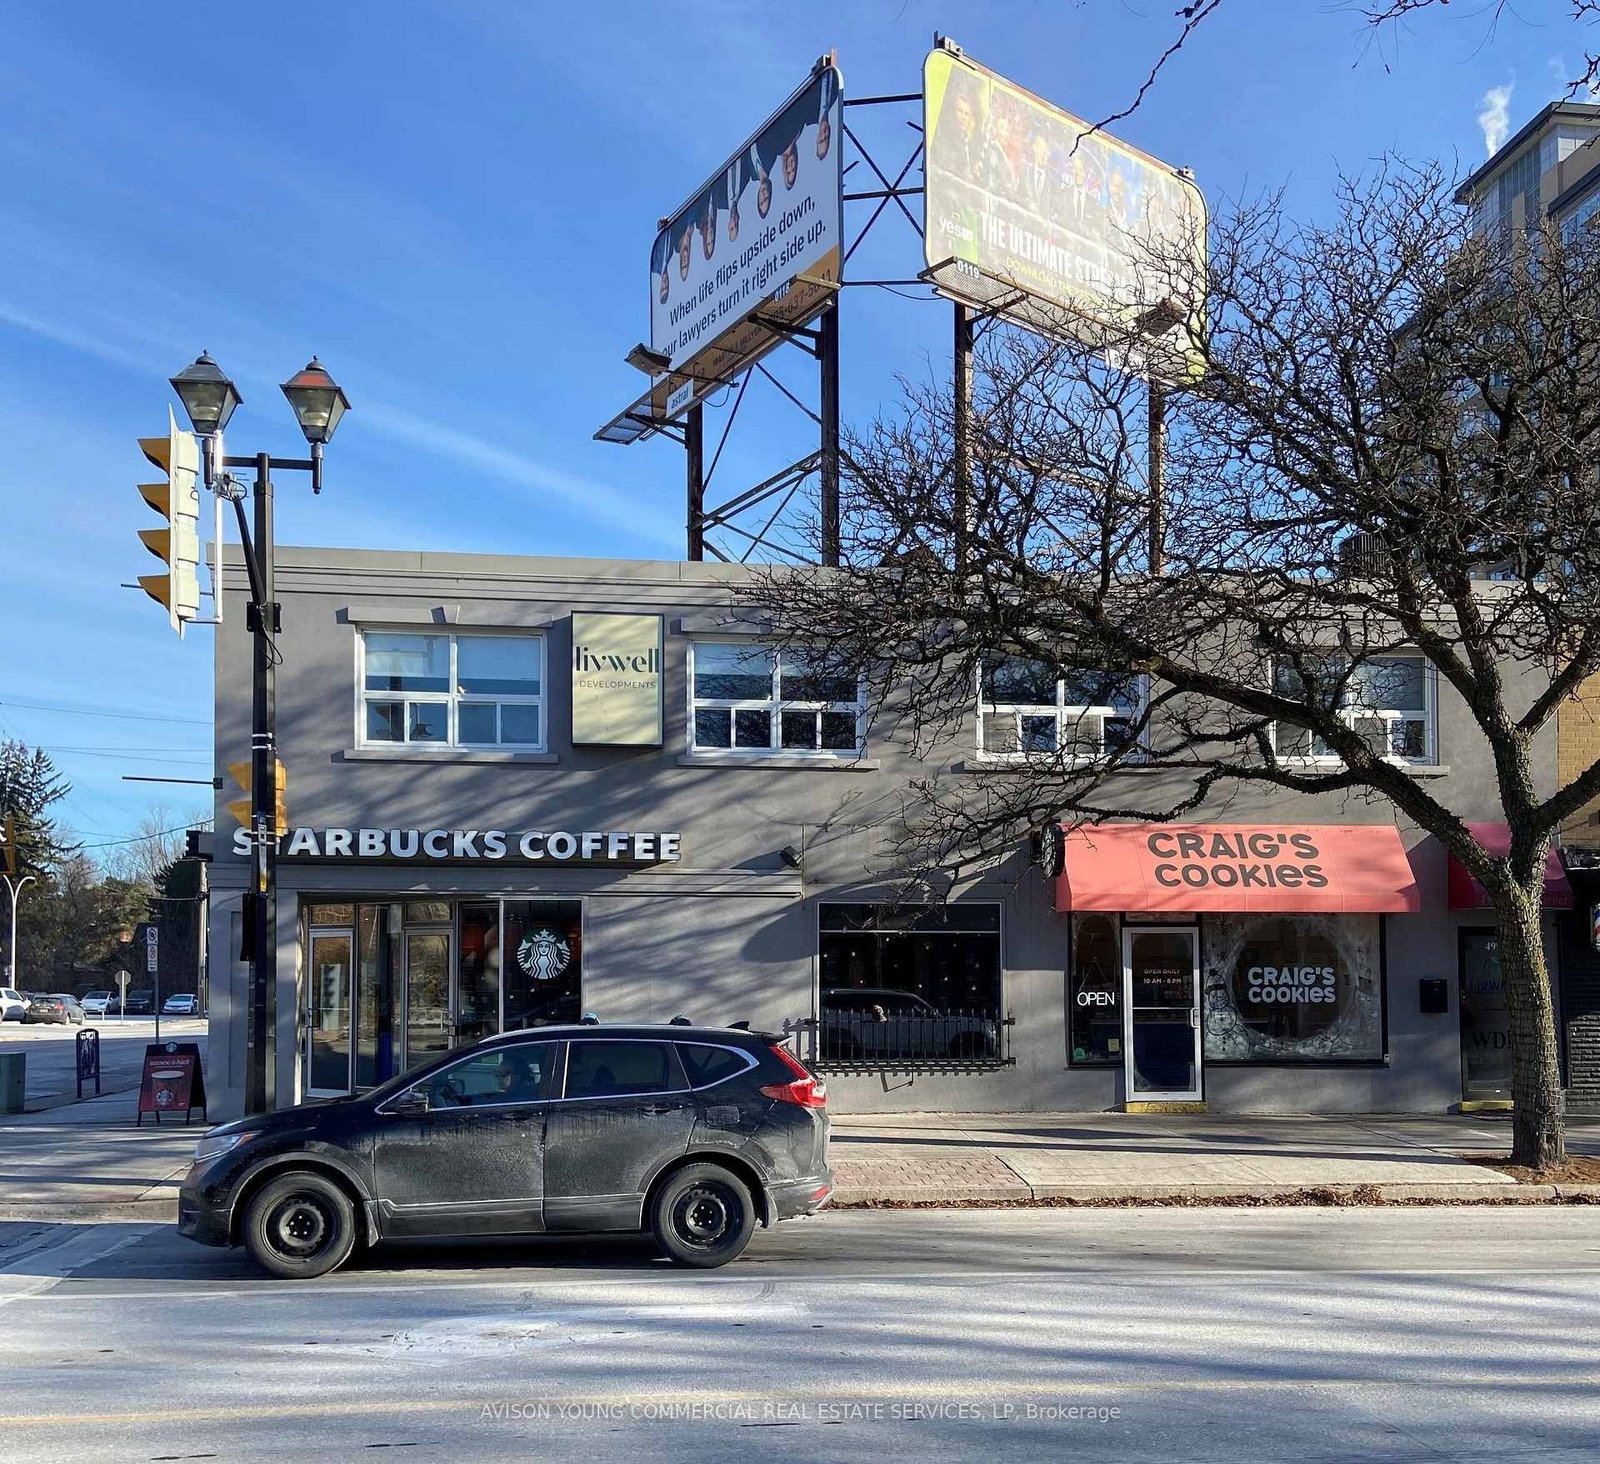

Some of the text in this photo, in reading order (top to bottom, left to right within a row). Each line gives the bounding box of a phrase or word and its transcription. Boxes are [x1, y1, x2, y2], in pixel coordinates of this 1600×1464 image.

[979, 209, 1006, 250] THE
[1009, 222, 1072, 278] ULTIMATE
[669, 196, 815, 326] When life flips upside down,
[957, 260, 980, 279] 0119
[680, 310, 716, 348] lawyers
[719, 289, 739, 317] turn
[742, 278, 749, 299] it
[752, 254, 778, 290] right
[780, 235, 804, 267] side
[807, 219, 826, 244] up.
[671, 387, 689, 409] astral
[576, 646, 659, 673] livwell
[579, 680, 656, 689] DEVELOPMENTS
[232, 826, 507, 859] SARBUCKS
[518, 830, 682, 861] COFFEE
[1147, 832, 1320, 860] CRAIG'S
[1248, 966, 1336, 985] CRAIG'S
[1077, 992, 1115, 1006] OPEN
